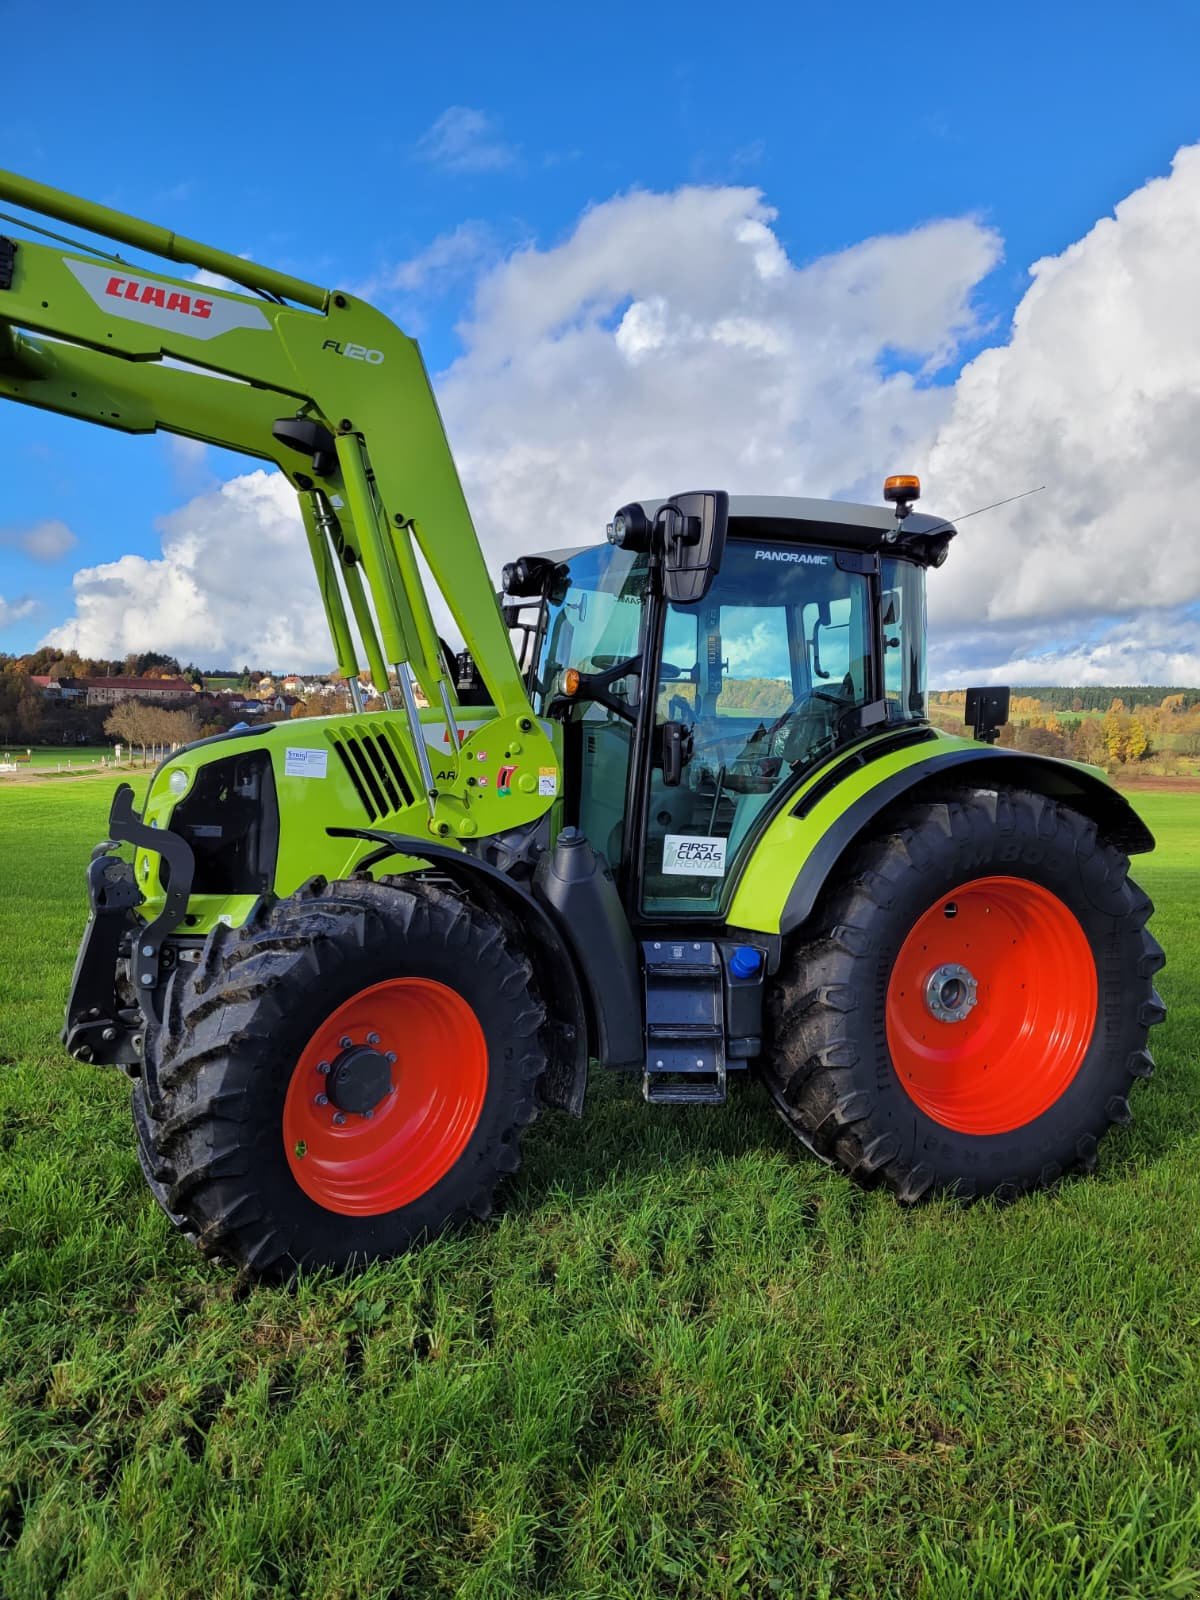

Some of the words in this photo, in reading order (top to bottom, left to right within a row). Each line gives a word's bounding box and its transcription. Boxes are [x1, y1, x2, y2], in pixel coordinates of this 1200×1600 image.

[105, 276, 213, 319] CLAAS
[754, 550, 828, 565] PANORAMIC
[436, 770, 458, 780] AR
[679, 842, 718, 853] FIRST
[676, 850, 723, 861] CLAAS
[674, 859, 724, 870] RENTAL
